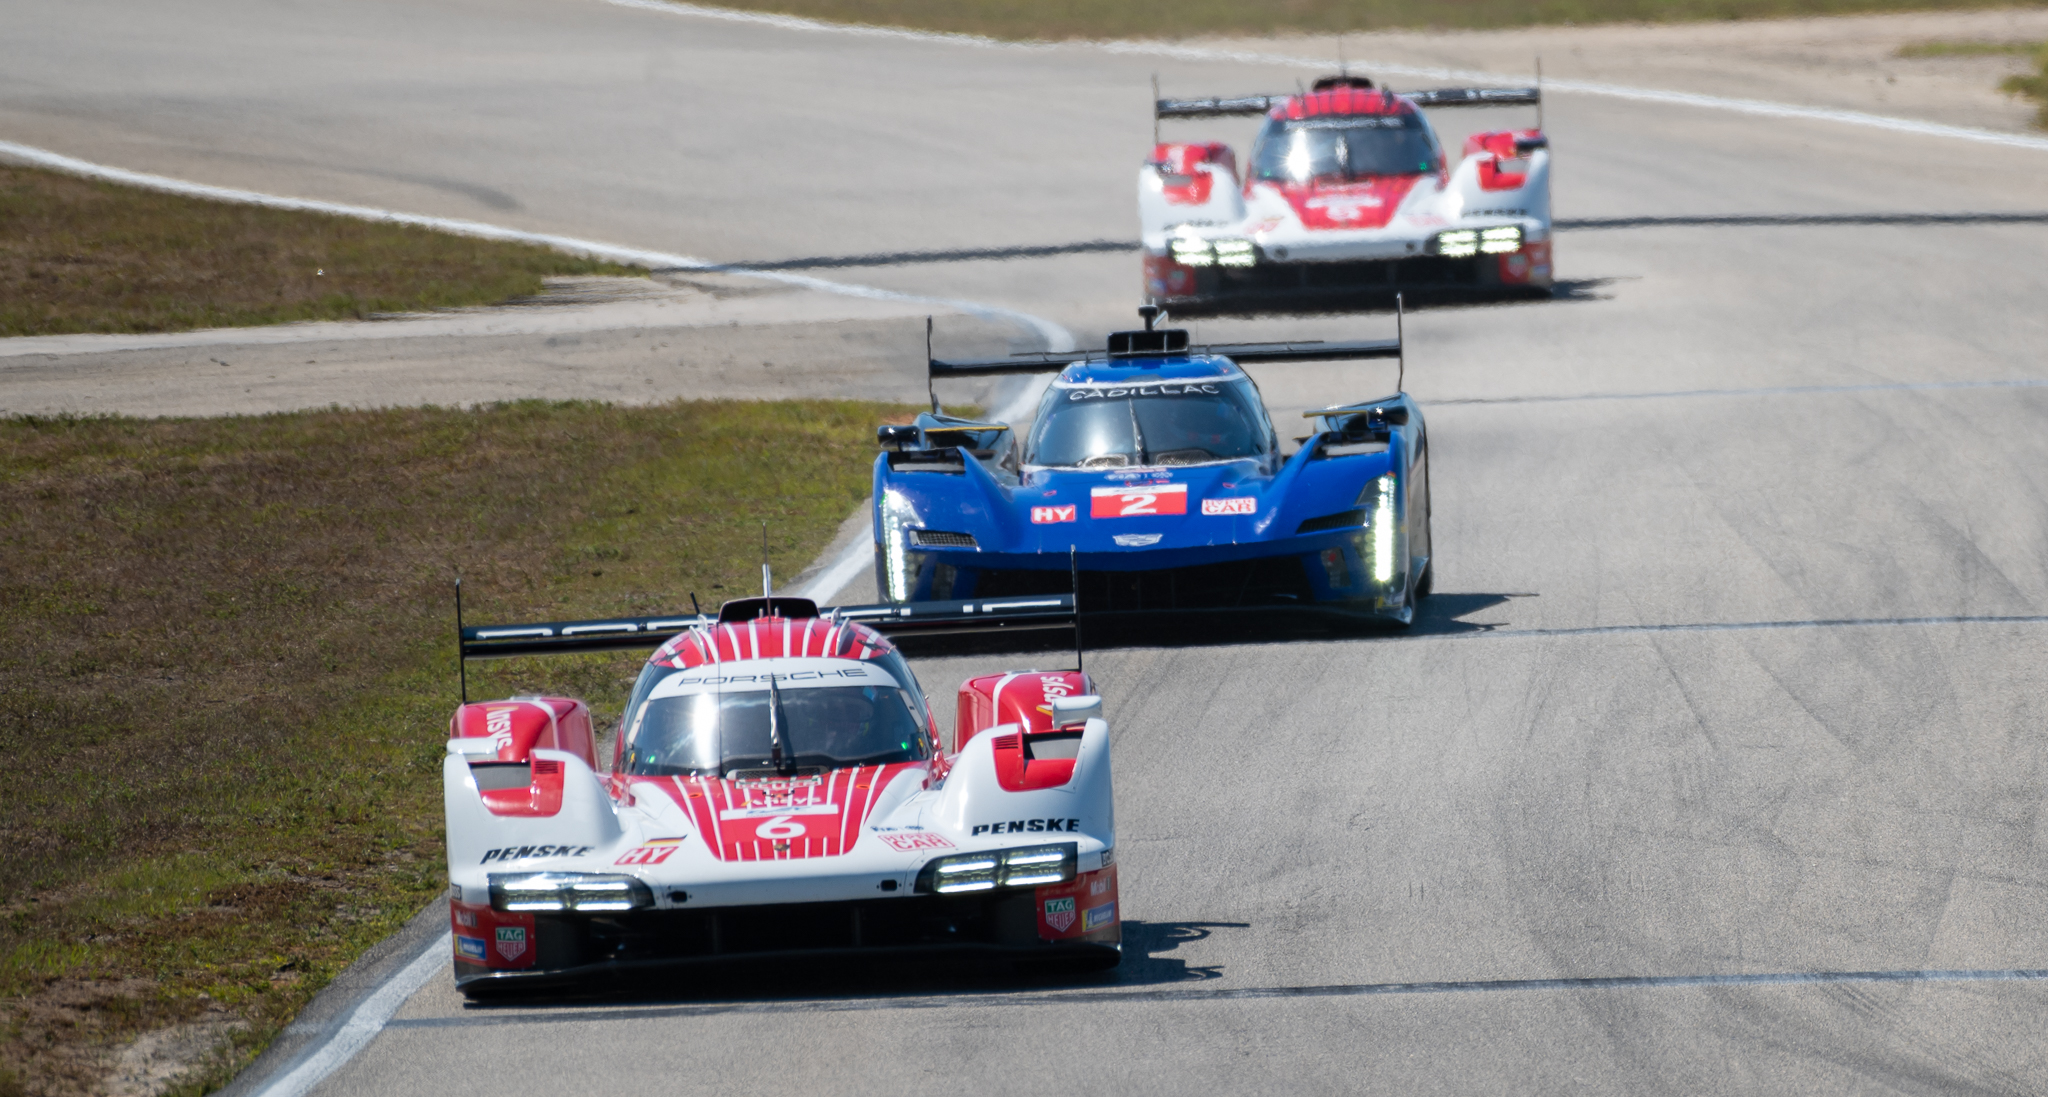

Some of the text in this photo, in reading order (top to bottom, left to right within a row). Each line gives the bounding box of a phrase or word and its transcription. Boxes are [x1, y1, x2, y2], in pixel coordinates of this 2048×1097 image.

[1070, 384, 1220, 401] CADILLAC
[1120, 494, 1157, 516] 2
[1205, 504, 1252, 514] CAR
[1033, 507, 1073, 522] HY
[678, 668, 868, 687] PORSCHE
[486, 706, 519, 751] Ansys
[755, 816, 806, 839] 6
[971, 818, 1080, 837] PENSKE
[893, 837, 944, 850] CAR
[479, 845, 595, 865] PENSKE
[623, 847, 673, 864] HY
[1048, 901, 1073, 912] TAG
[1047, 912, 1075, 930] HEUER
[499, 929, 523, 940] TAG
[499, 941, 523, 960] HEUER
